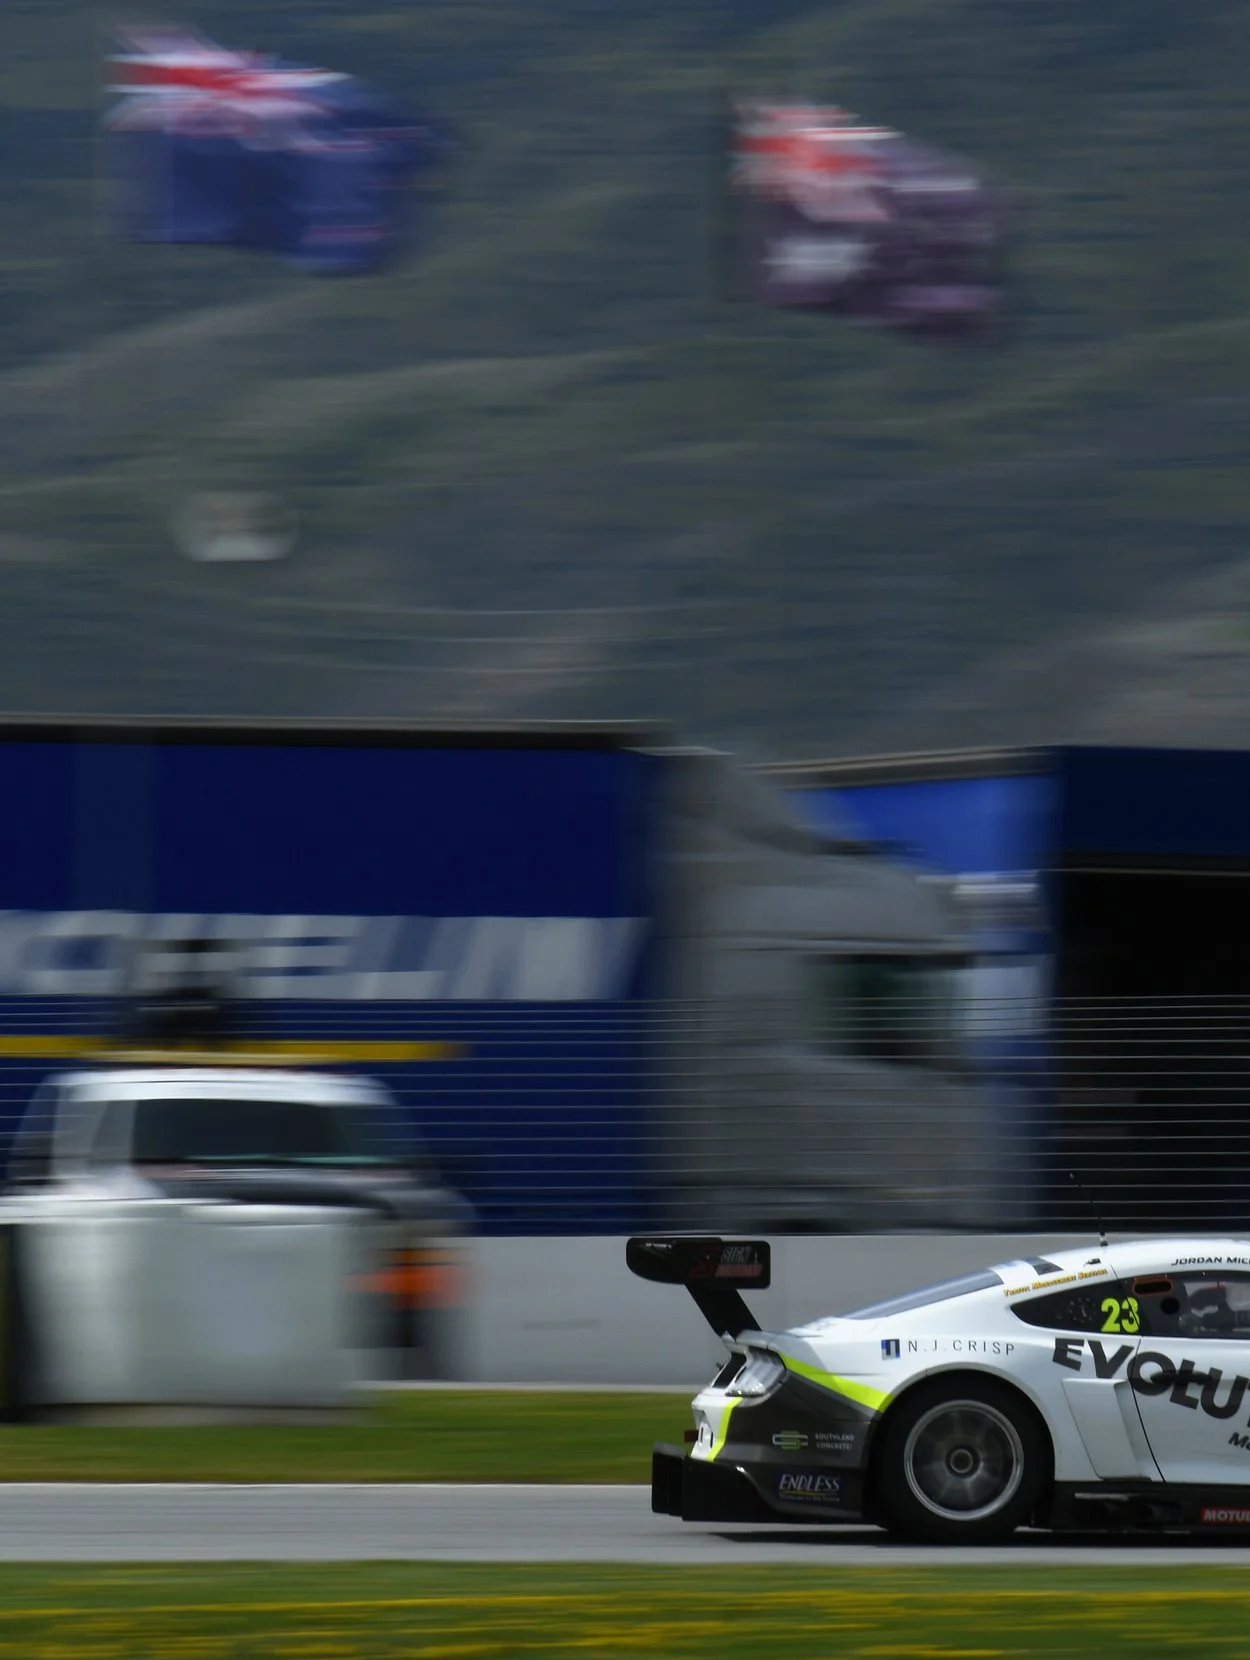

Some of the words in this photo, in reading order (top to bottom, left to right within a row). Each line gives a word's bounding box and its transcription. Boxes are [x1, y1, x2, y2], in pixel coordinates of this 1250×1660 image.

[1171, 1256, 1223, 1266] JORDAN
[1101, 1297, 1140, 1333] 23
[815, 1432, 855, 1442] SOUTHLAND
[779, 1473, 841, 1492] ENDLESS
